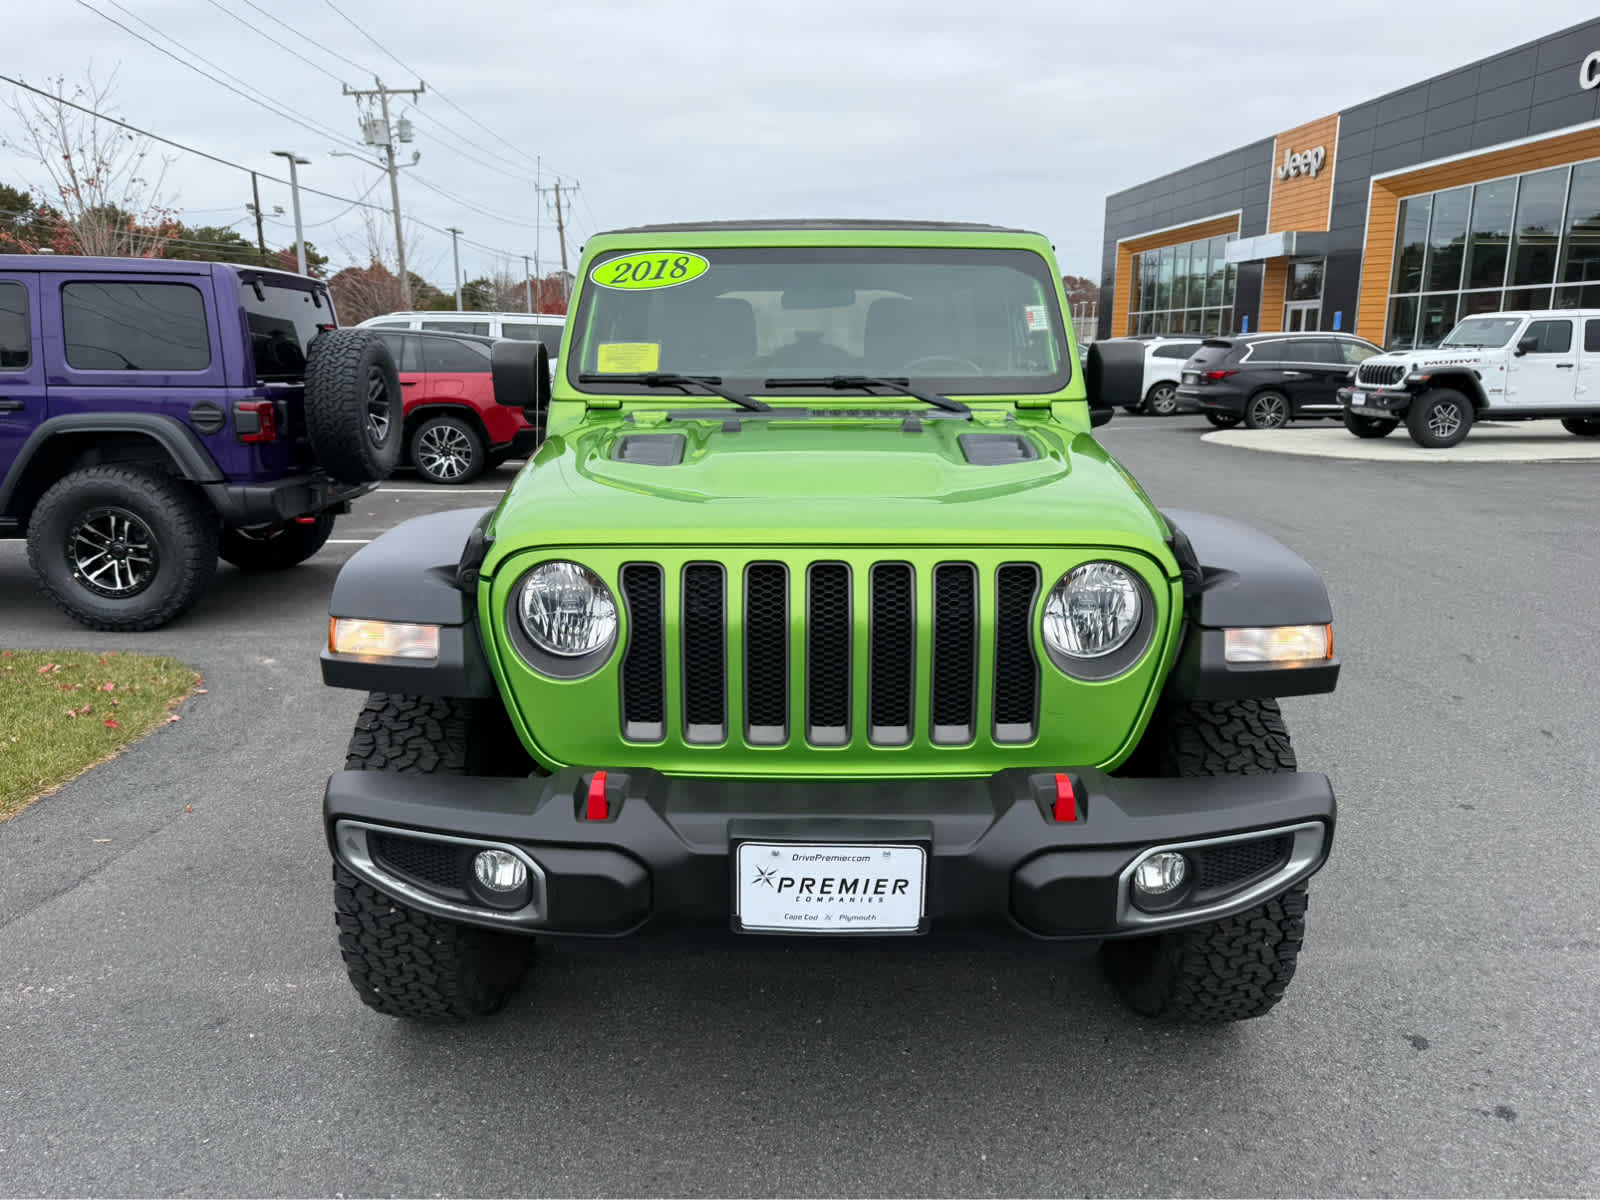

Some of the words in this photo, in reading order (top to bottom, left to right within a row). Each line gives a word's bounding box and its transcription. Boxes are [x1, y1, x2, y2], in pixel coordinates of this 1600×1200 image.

[1277, 145, 1325, 179] Jeep
[610, 256, 690, 284] 2018
[777, 877, 909, 895] PREMIER
[784, 913, 802, 922] Cape
[804, 913, 818, 921] Cod
[839, 913, 877, 922] Plymouth
